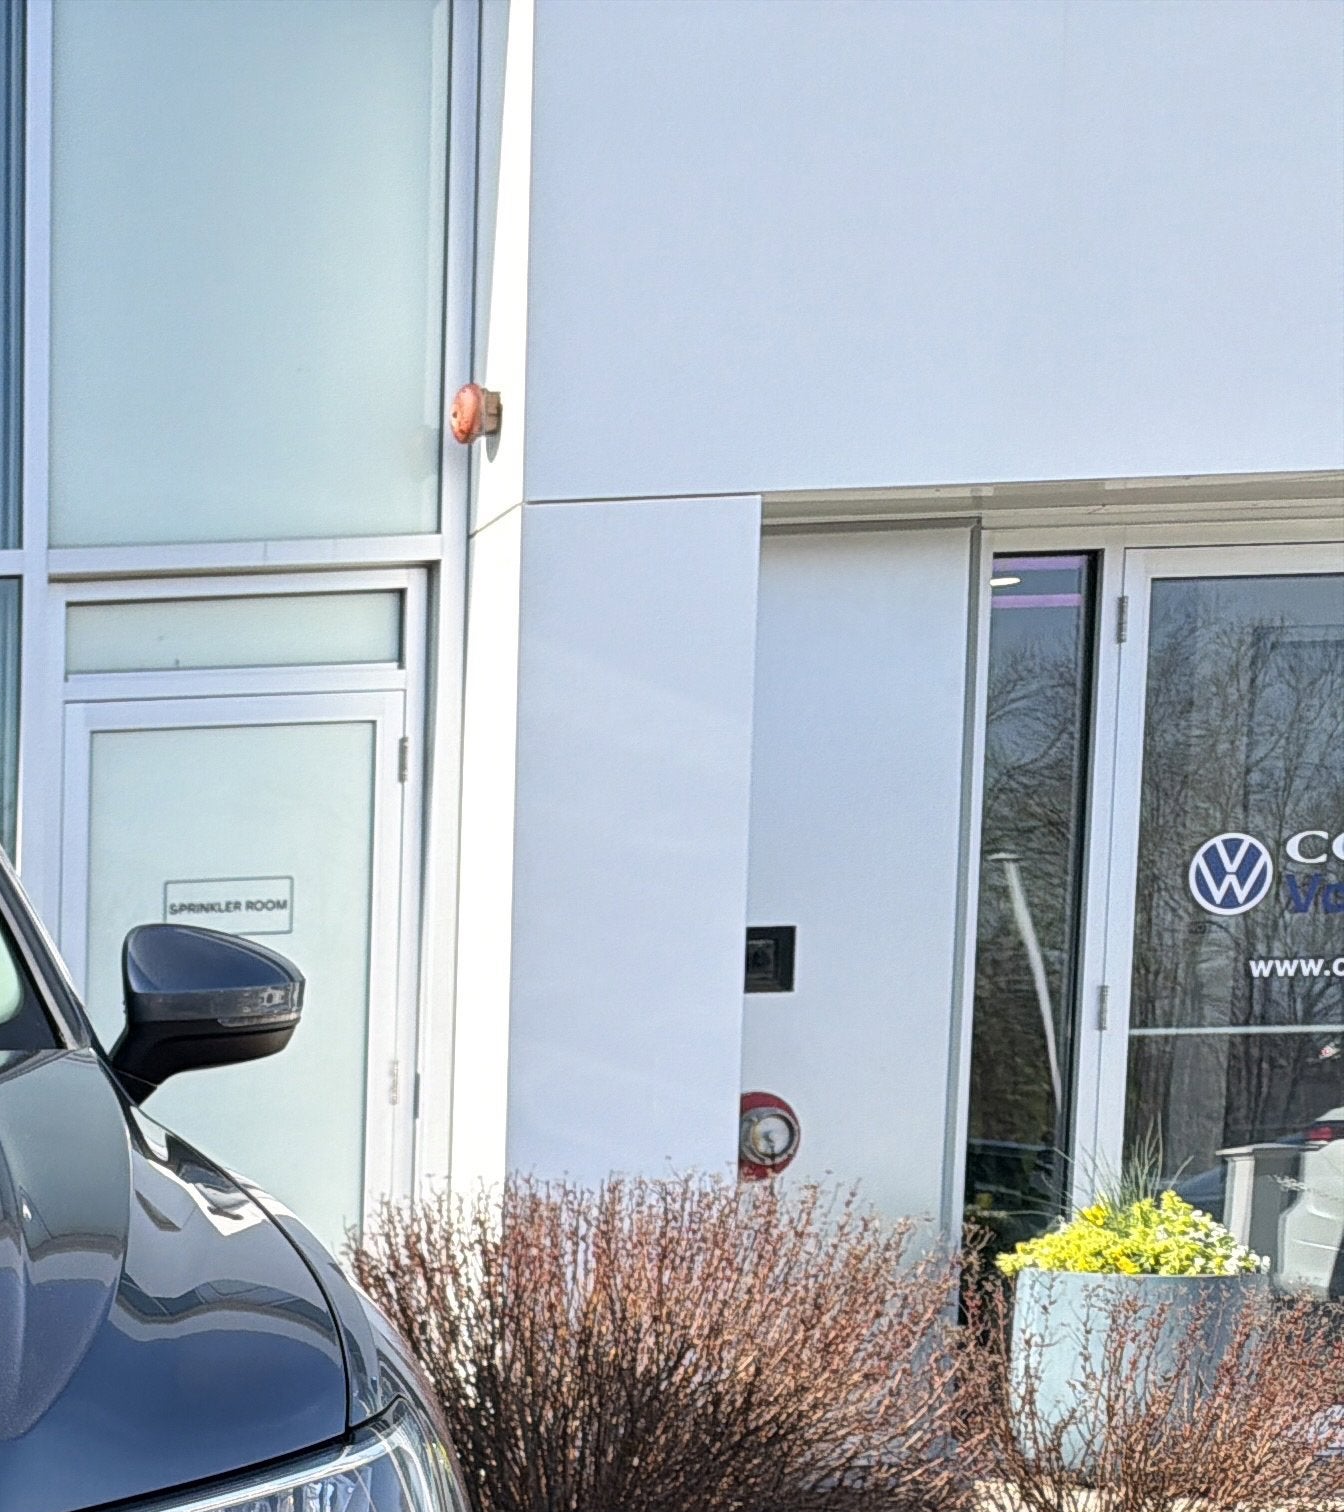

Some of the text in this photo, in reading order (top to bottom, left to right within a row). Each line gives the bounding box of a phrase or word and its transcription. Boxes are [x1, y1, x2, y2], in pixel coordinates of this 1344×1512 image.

[1286, 830, 1344, 864] C
[169, 899, 288, 915] SPRINKLER ROOM
